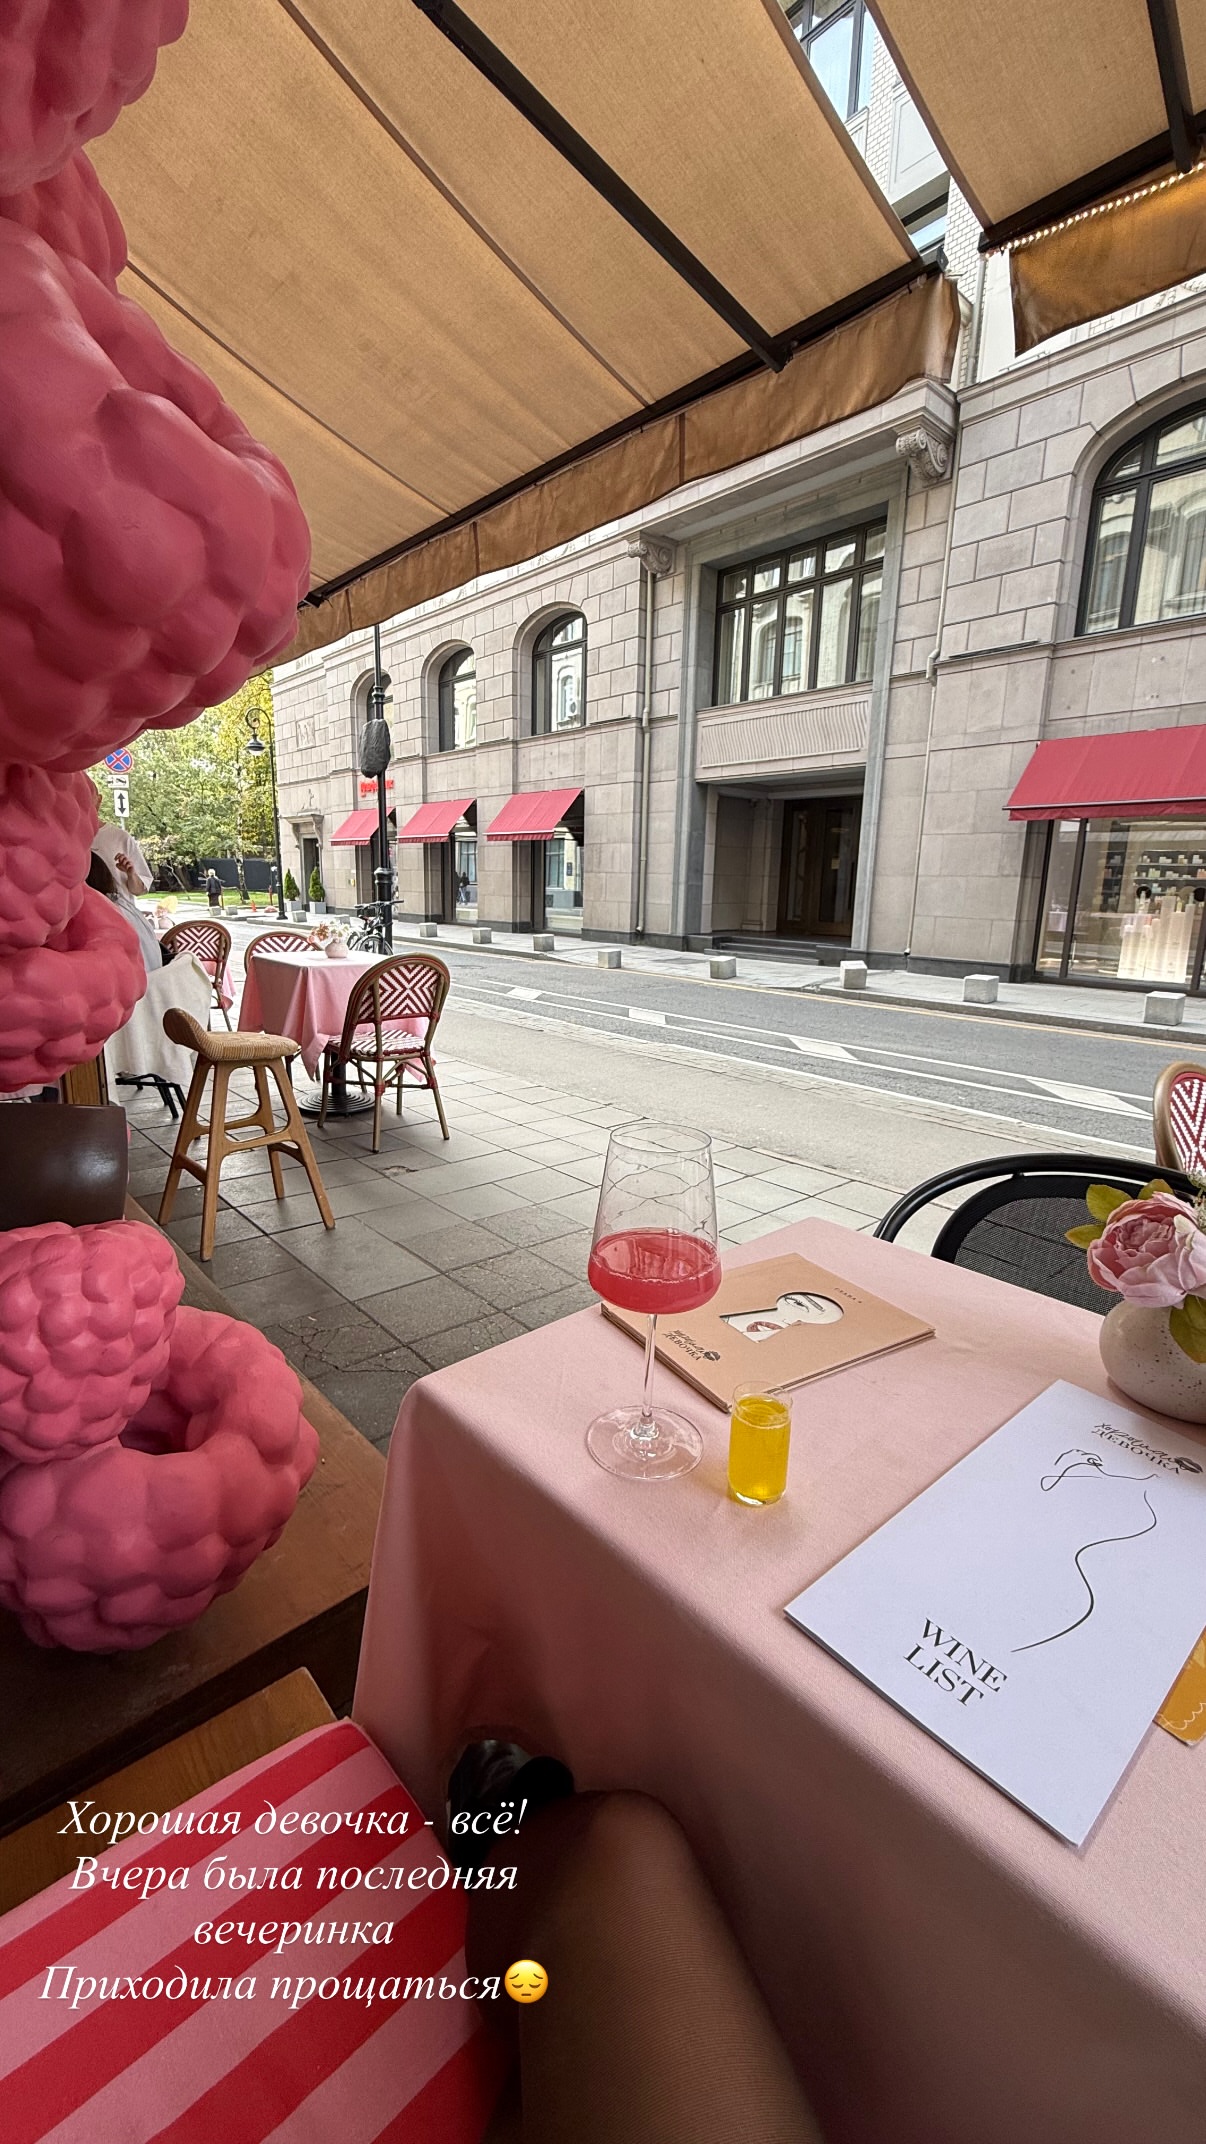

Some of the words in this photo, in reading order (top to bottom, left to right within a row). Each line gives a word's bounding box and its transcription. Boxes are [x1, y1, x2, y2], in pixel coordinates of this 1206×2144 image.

[1091, 1428, 1180, 1475] ДЕВОЧКА
[903, 1643, 985, 1707] LIST
[922, 1617, 1008, 1693] WINE
